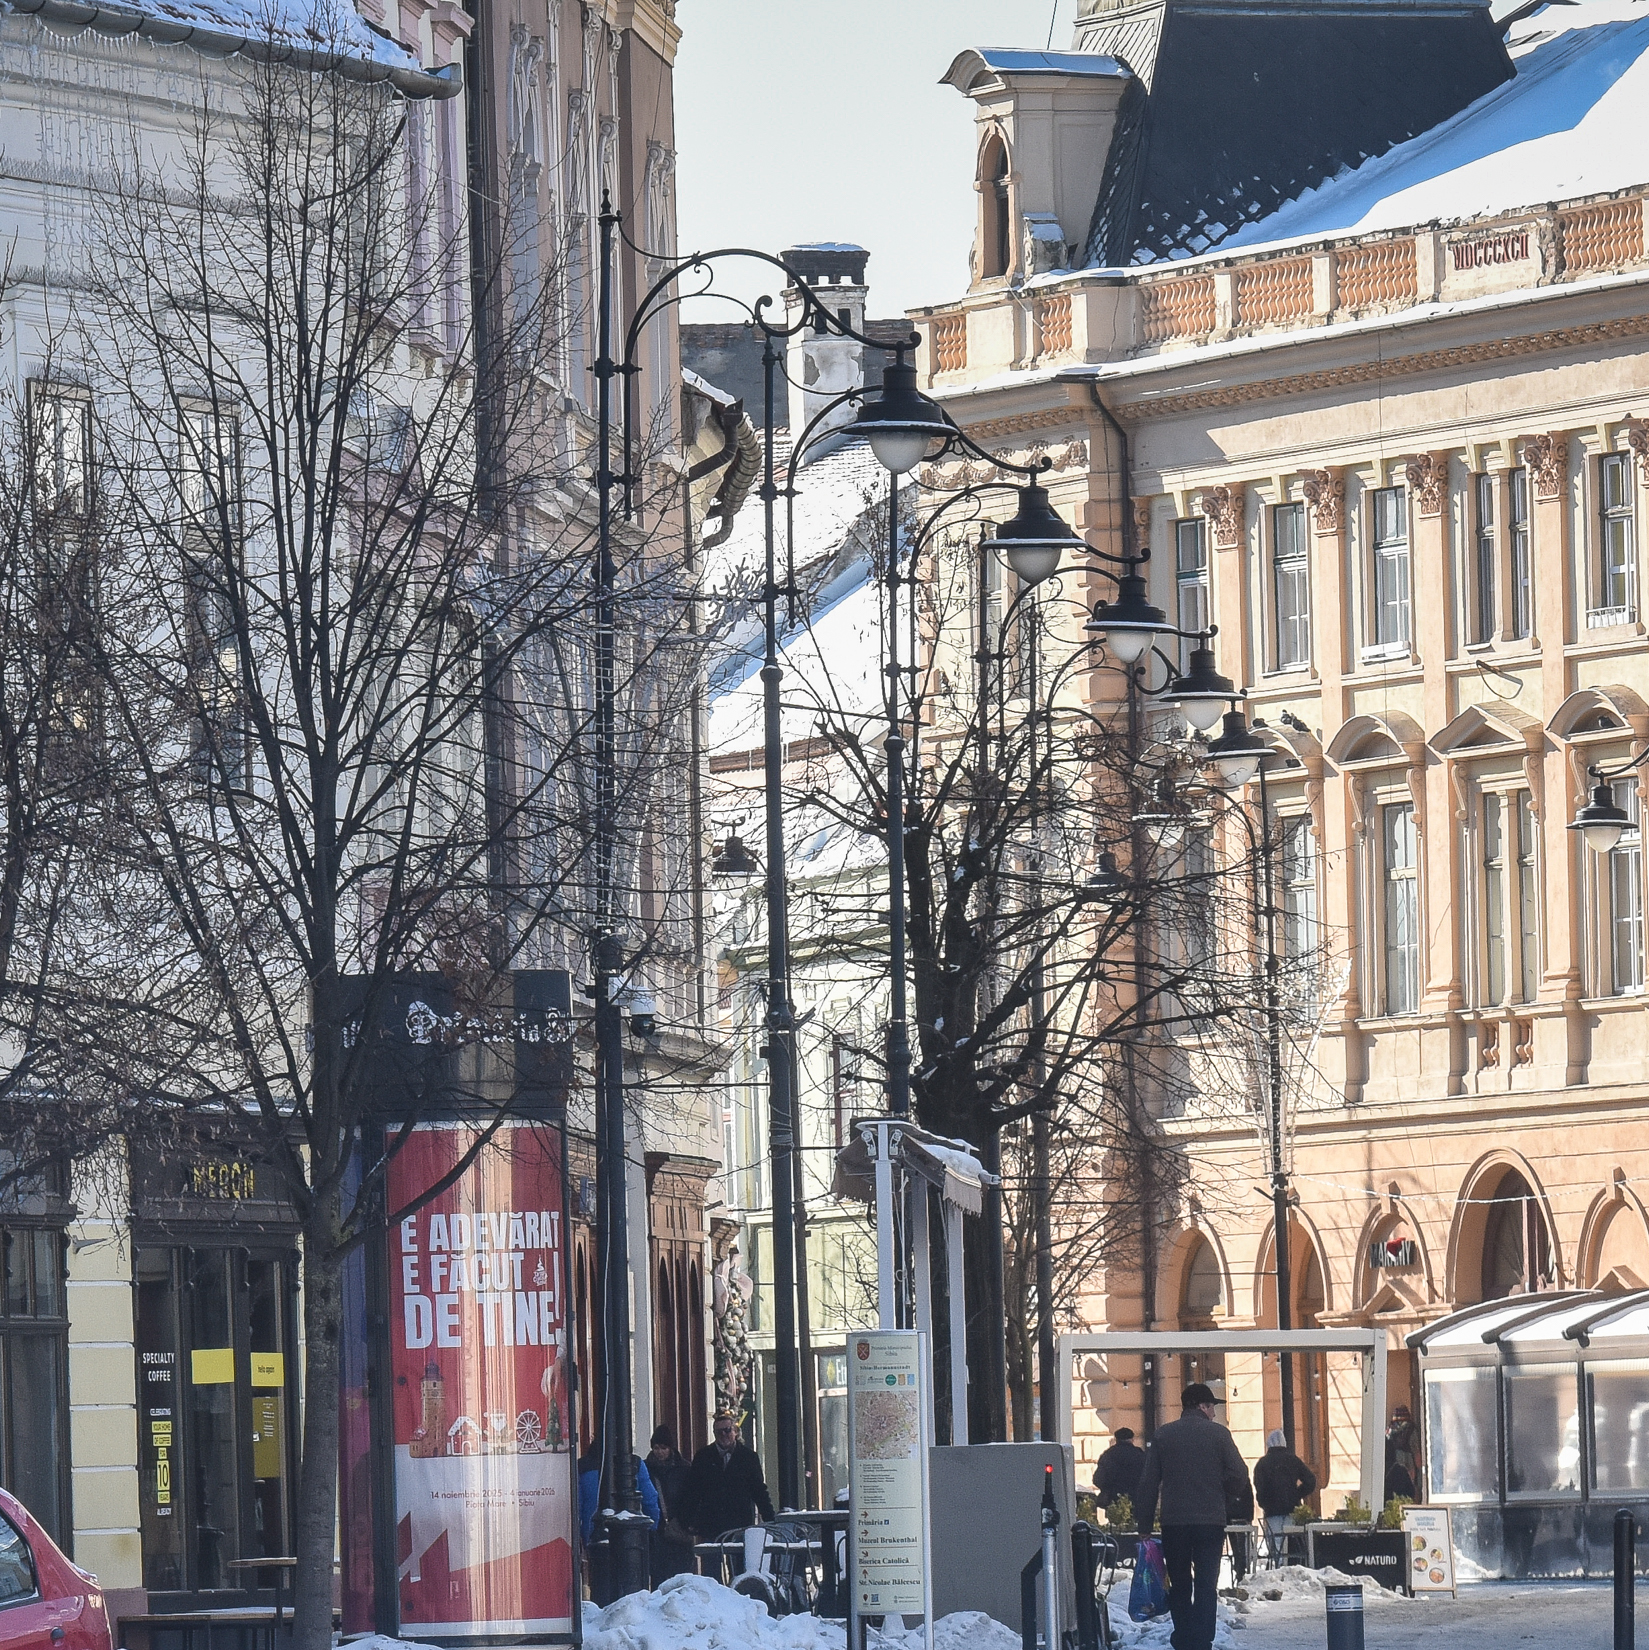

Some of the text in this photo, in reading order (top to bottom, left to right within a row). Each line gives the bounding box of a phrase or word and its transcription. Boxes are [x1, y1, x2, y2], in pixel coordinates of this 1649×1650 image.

[401, 1211, 560, 1252] E ADEVĂRAT
[402, 1255, 420, 1293] E
[430, 1252, 524, 1292] FĂCUT
[404, 1252, 562, 1349] DE TINE!
[142, 1353, 174, 1364] SPECIALTY
[148, 1371, 171, 1382] COFFEE
[158, 1464, 168, 1487] 10
[431, 1491, 439, 1499] 14
[518, 1499, 535, 1507] Sibiu
[881, 1536, 918, 1544] Brukenthal
